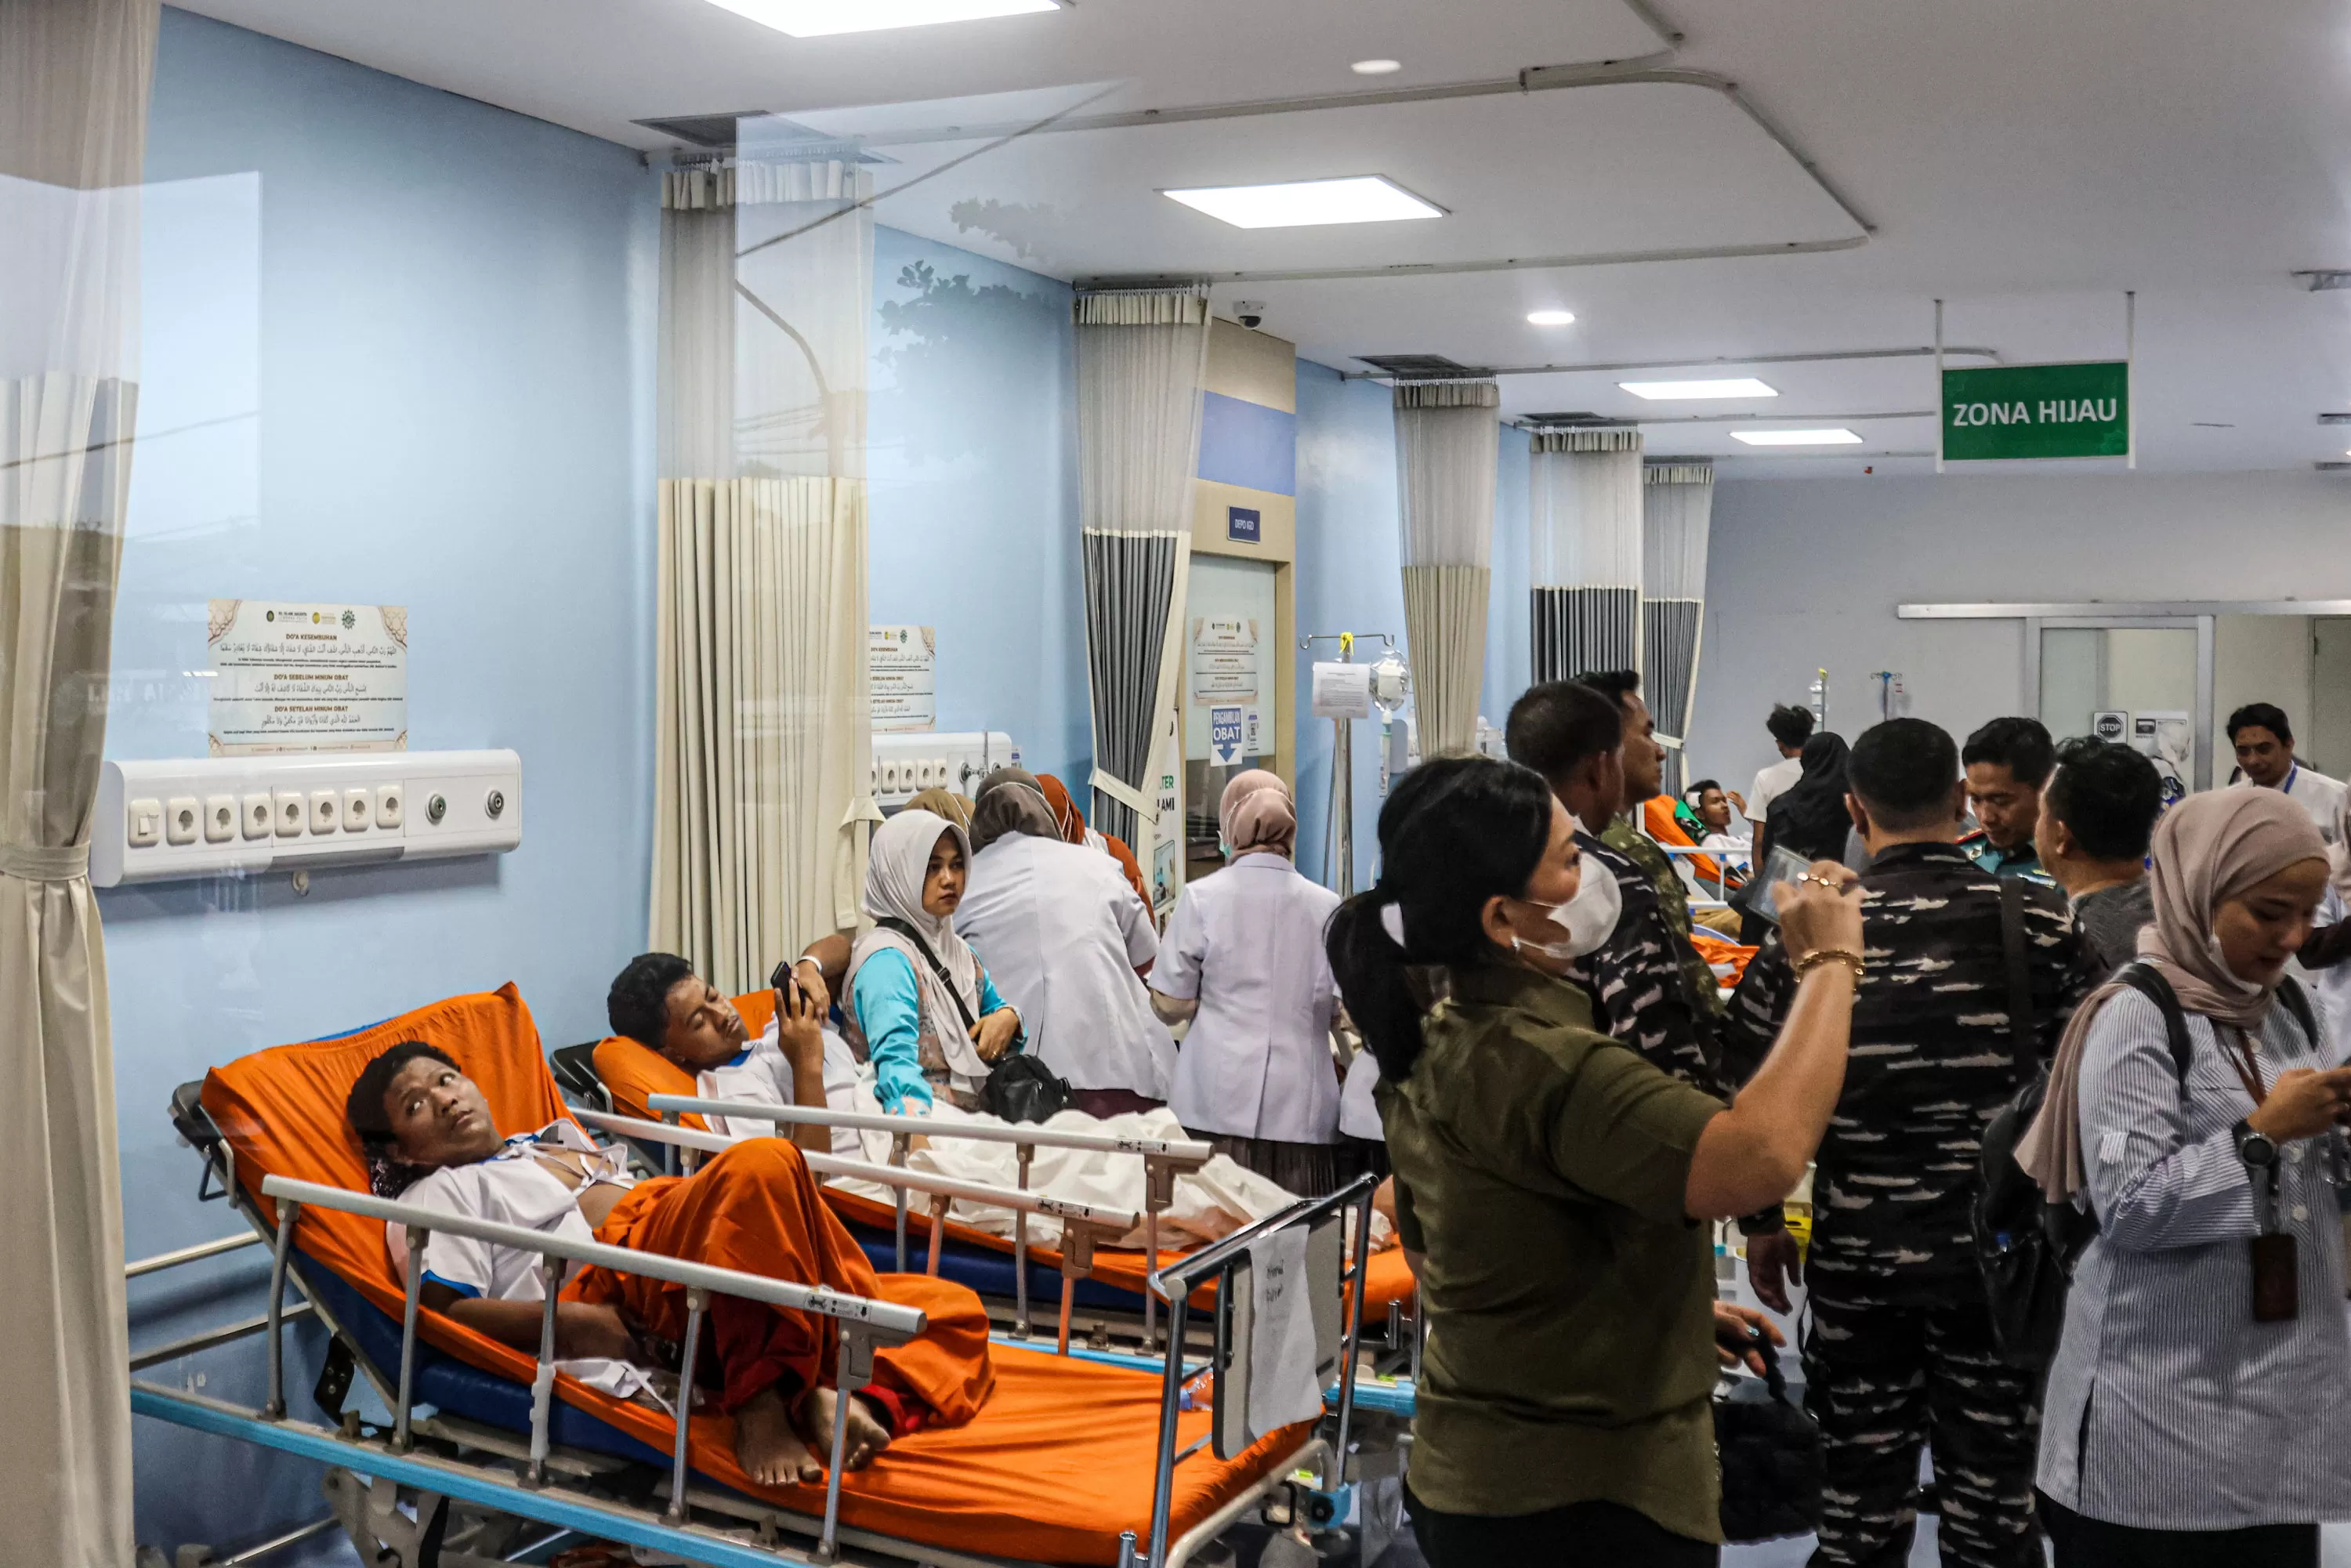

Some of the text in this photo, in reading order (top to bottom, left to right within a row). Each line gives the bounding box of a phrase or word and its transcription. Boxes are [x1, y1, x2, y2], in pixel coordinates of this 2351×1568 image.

[1953, 398, 2117, 426] ZONA HIJAU
[1235, 519, 1246, 530] DEPO
[1213, 712, 1240, 725] PENGAMBILAN
[1213, 726, 1240, 741] OBAT
[2100, 723, 2121, 732] STOP
